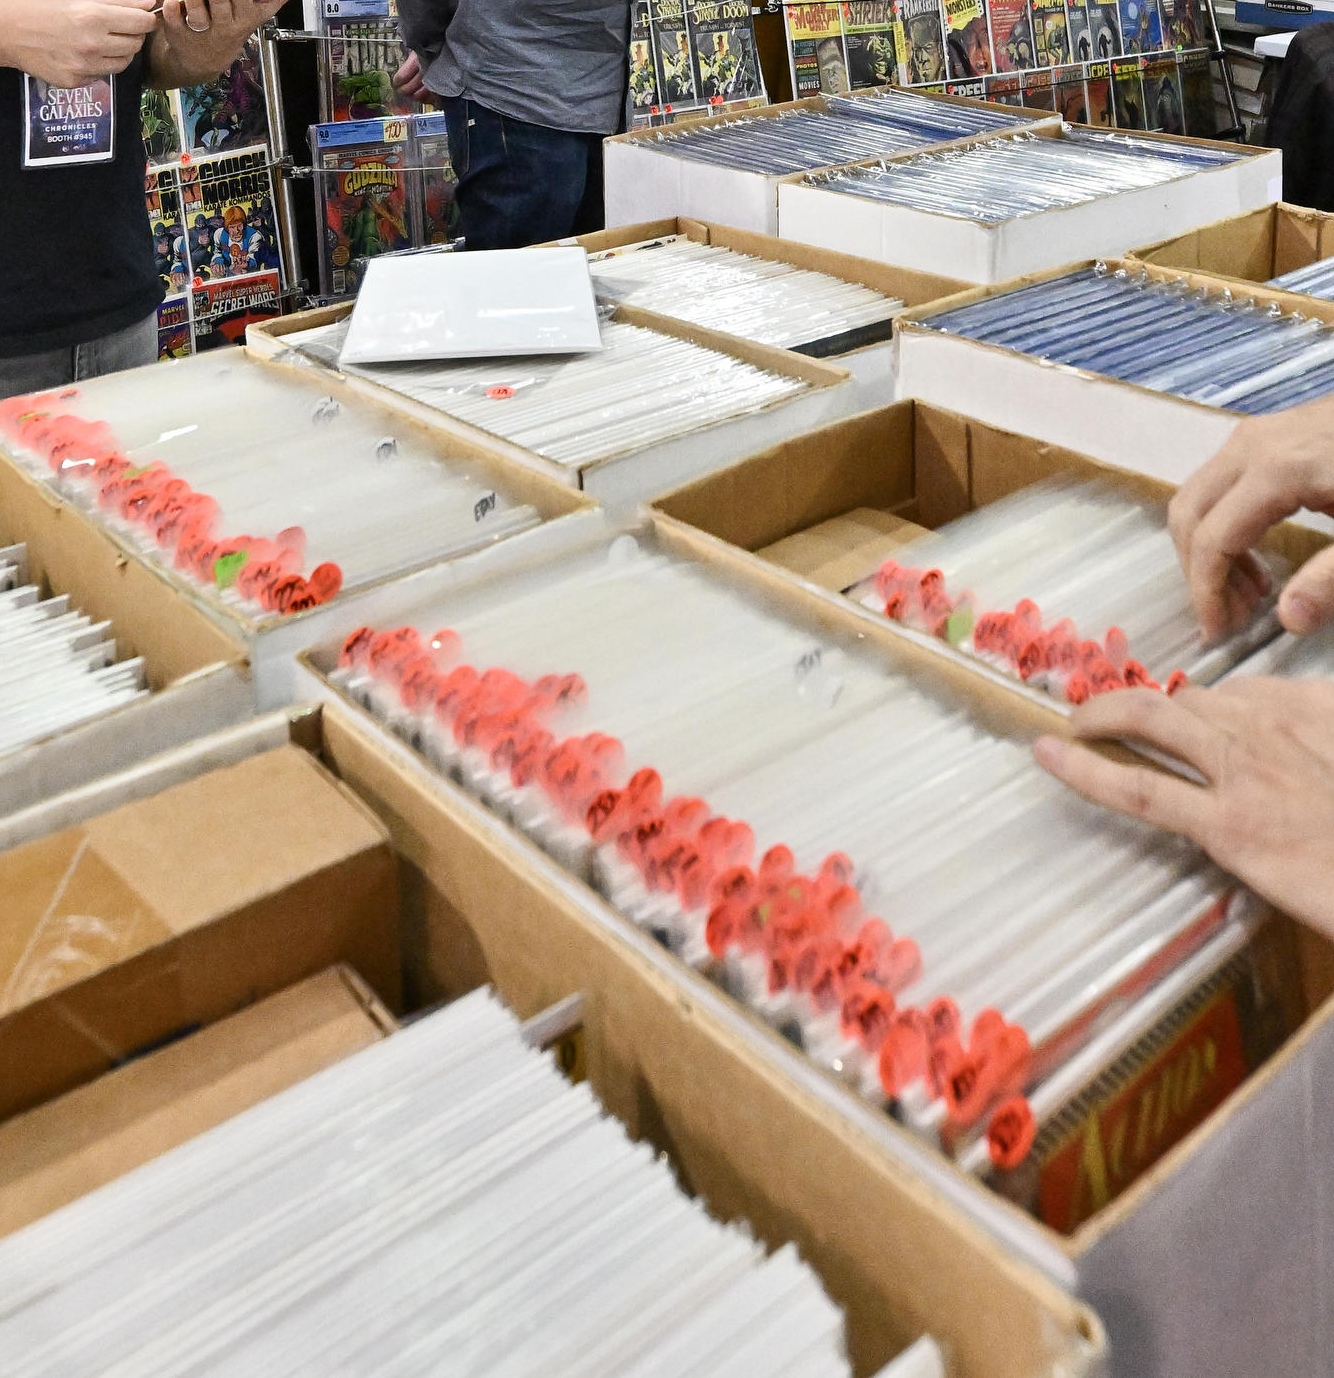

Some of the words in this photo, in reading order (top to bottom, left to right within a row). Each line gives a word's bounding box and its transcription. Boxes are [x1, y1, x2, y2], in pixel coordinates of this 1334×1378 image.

[326, 3, 340, 15] 8.0
[722, 4, 749, 19] DOOM
[798, 80, 820, 89] MOVIES
[48, 87, 93, 105] SEVEN
[39, 102, 103, 123] GALAXIES
[45, 123, 96, 132] CHRONICLES
[47, 135, 72, 143] BOOTH
[198, 151, 267, 180] CHUCK
[202, 171, 272, 202] NORRIS
[204, 198, 227, 212] KARATE
[228, 191, 271, 207] KOMMANDOS
